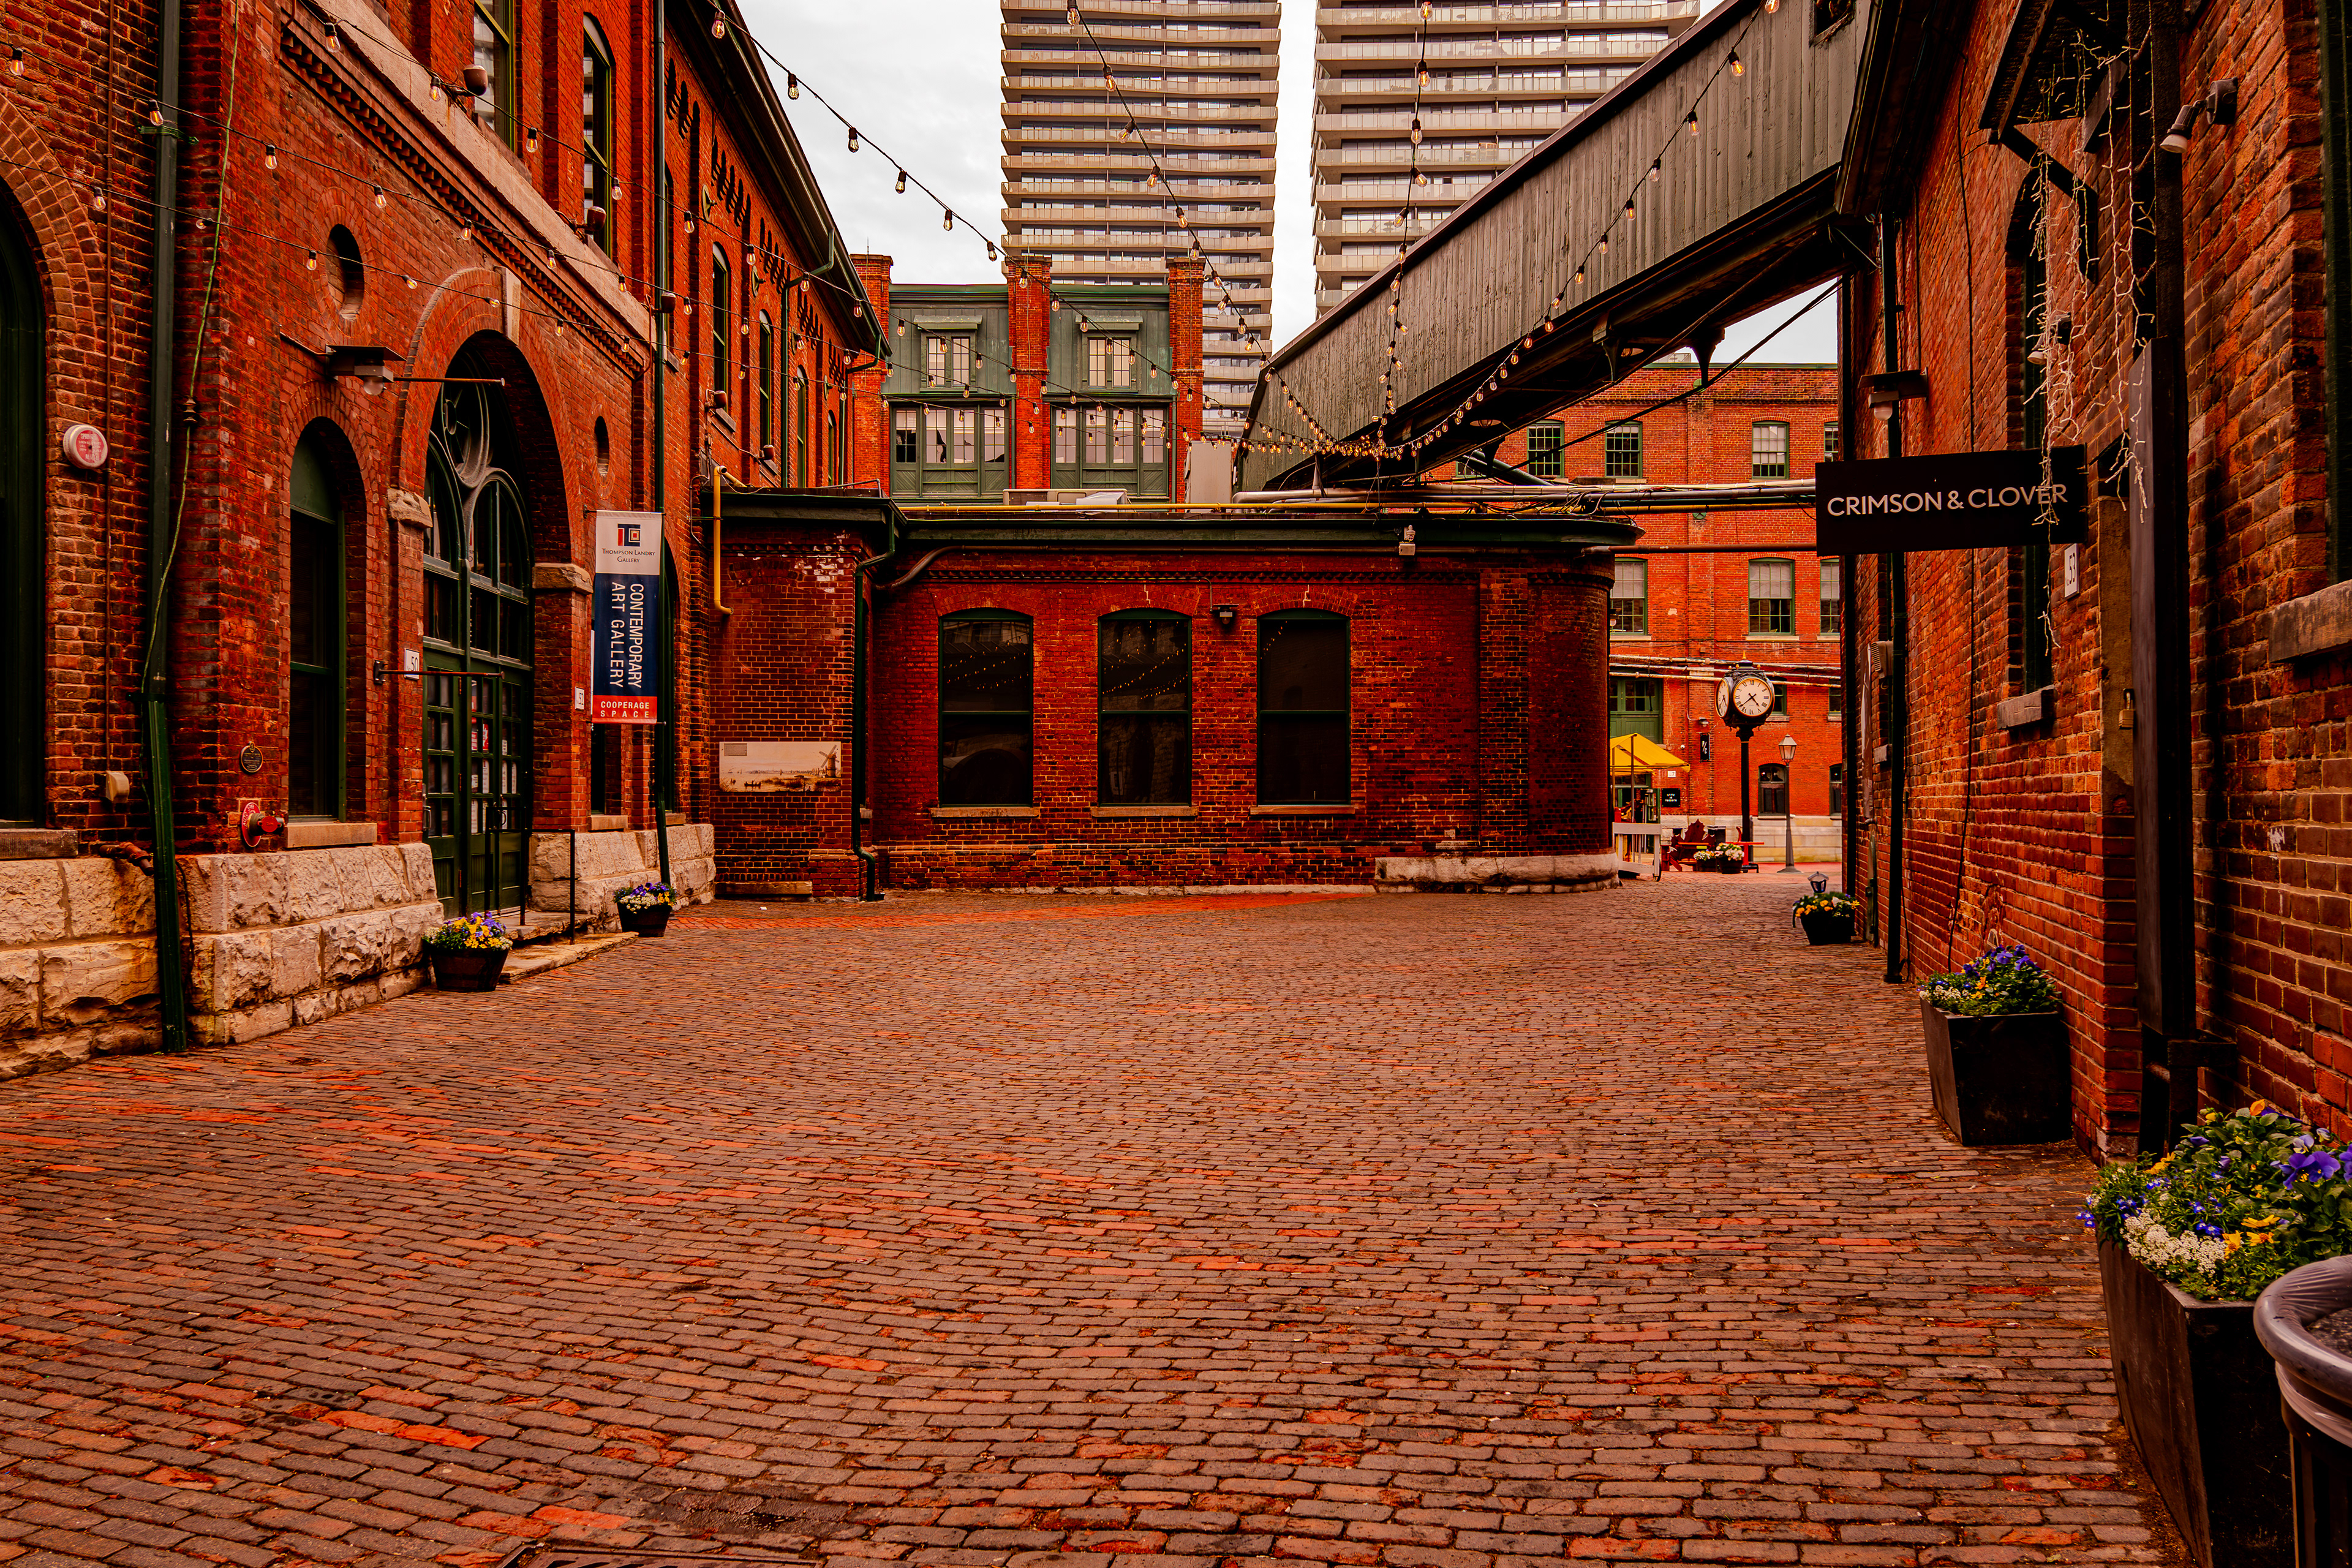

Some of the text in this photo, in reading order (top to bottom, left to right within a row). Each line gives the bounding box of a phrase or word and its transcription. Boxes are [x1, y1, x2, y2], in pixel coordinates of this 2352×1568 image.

[1828, 484, 2068, 516] CRIMSON & CLOVER
[2069, 552, 2076, 584] 53
[609, 582, 625, 688] ART GALLERY
[628, 583, 644, 688] CONTEMPORARY
[412, 657, 419, 671] 50
[579, 693, 584, 705] 52
